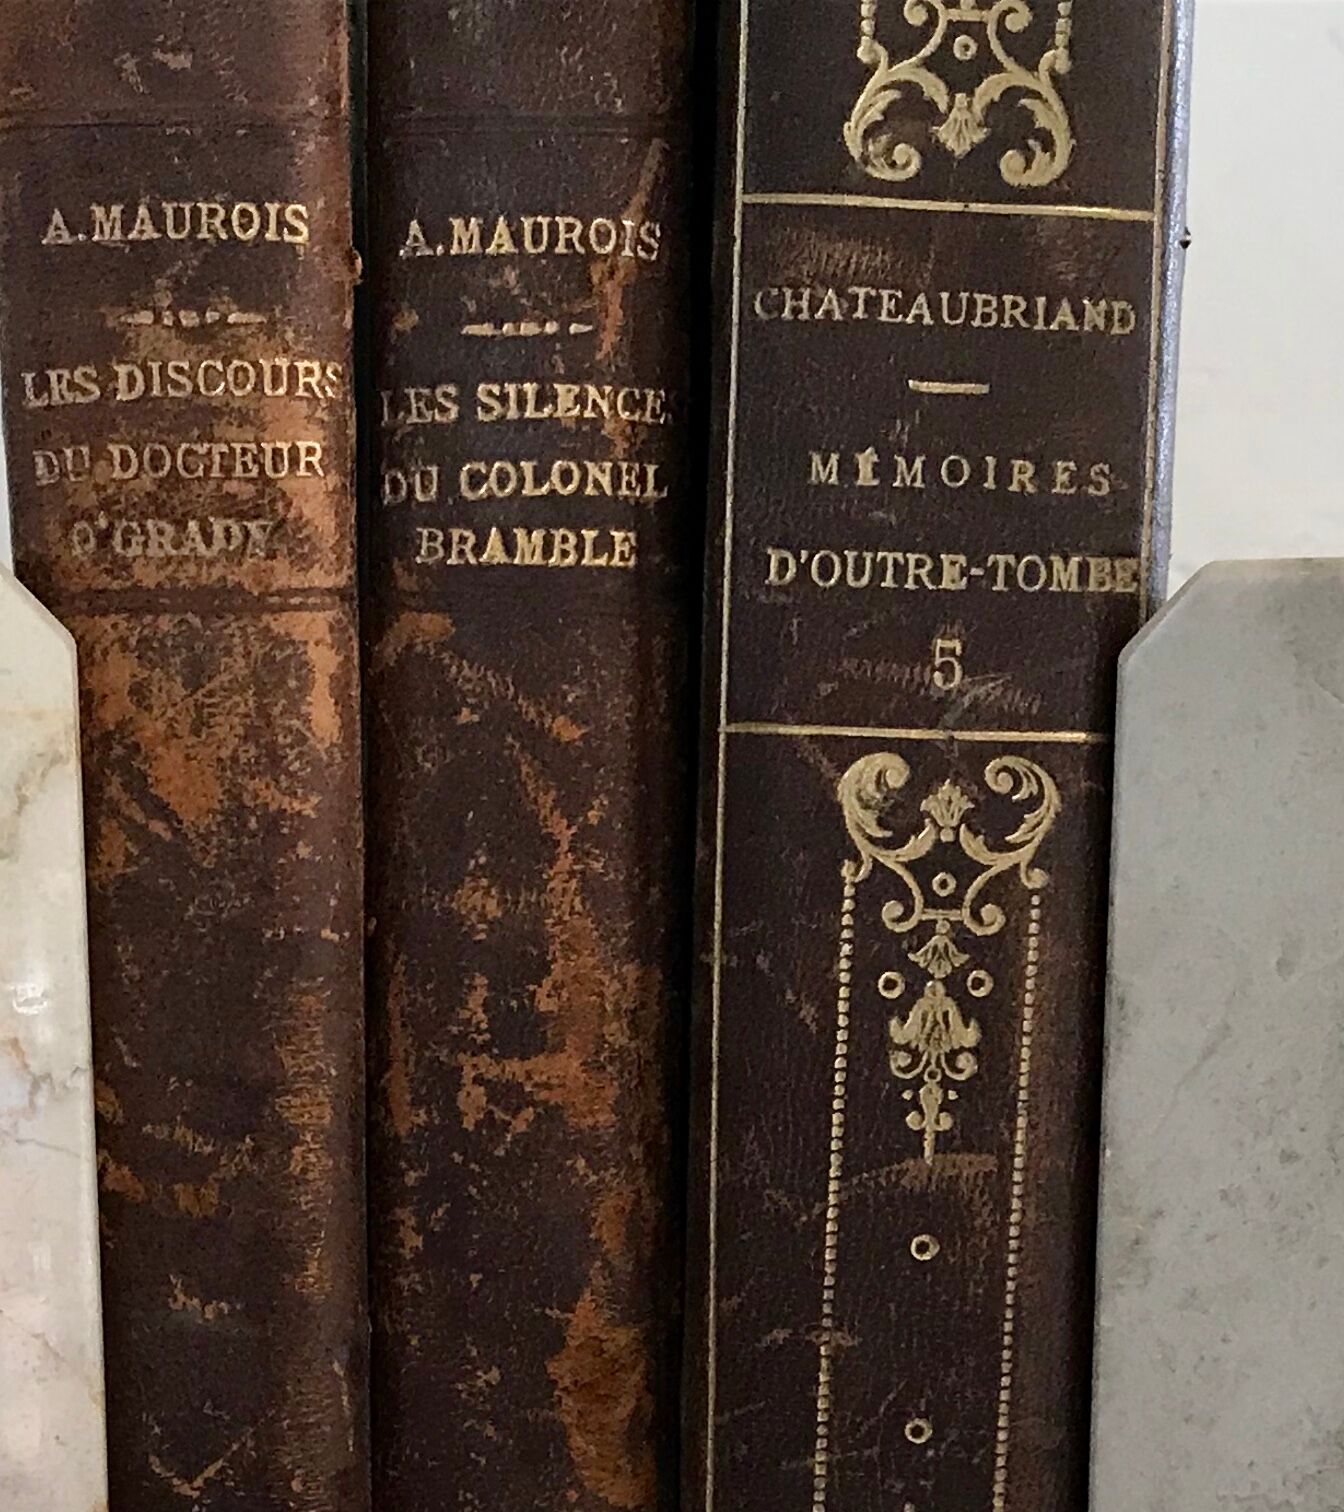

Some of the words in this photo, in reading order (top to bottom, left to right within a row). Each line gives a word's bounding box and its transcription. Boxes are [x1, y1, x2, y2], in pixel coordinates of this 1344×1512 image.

[41, 202, 310, 246] A.MAUROIS
[398, 215, 661, 261] A.MAUROIS
[755, 287, 1136, 334] CHATEAUBRIAND
[21, 364, 102, 407] LES
[114, 359, 343, 401] DISCOURS
[380, 383, 460, 427] LES
[32, 446, 90, 486] DU
[111, 441, 325, 480] DOCTEUR
[383, 465, 439, 505] DU
[460, 459, 668, 500] COLONEL
[415, 527, 638, 568] BRAMBLE
[765, 547, 1143, 593] D'OUTRE-TOMBE
[932, 638, 963, 691] 5
